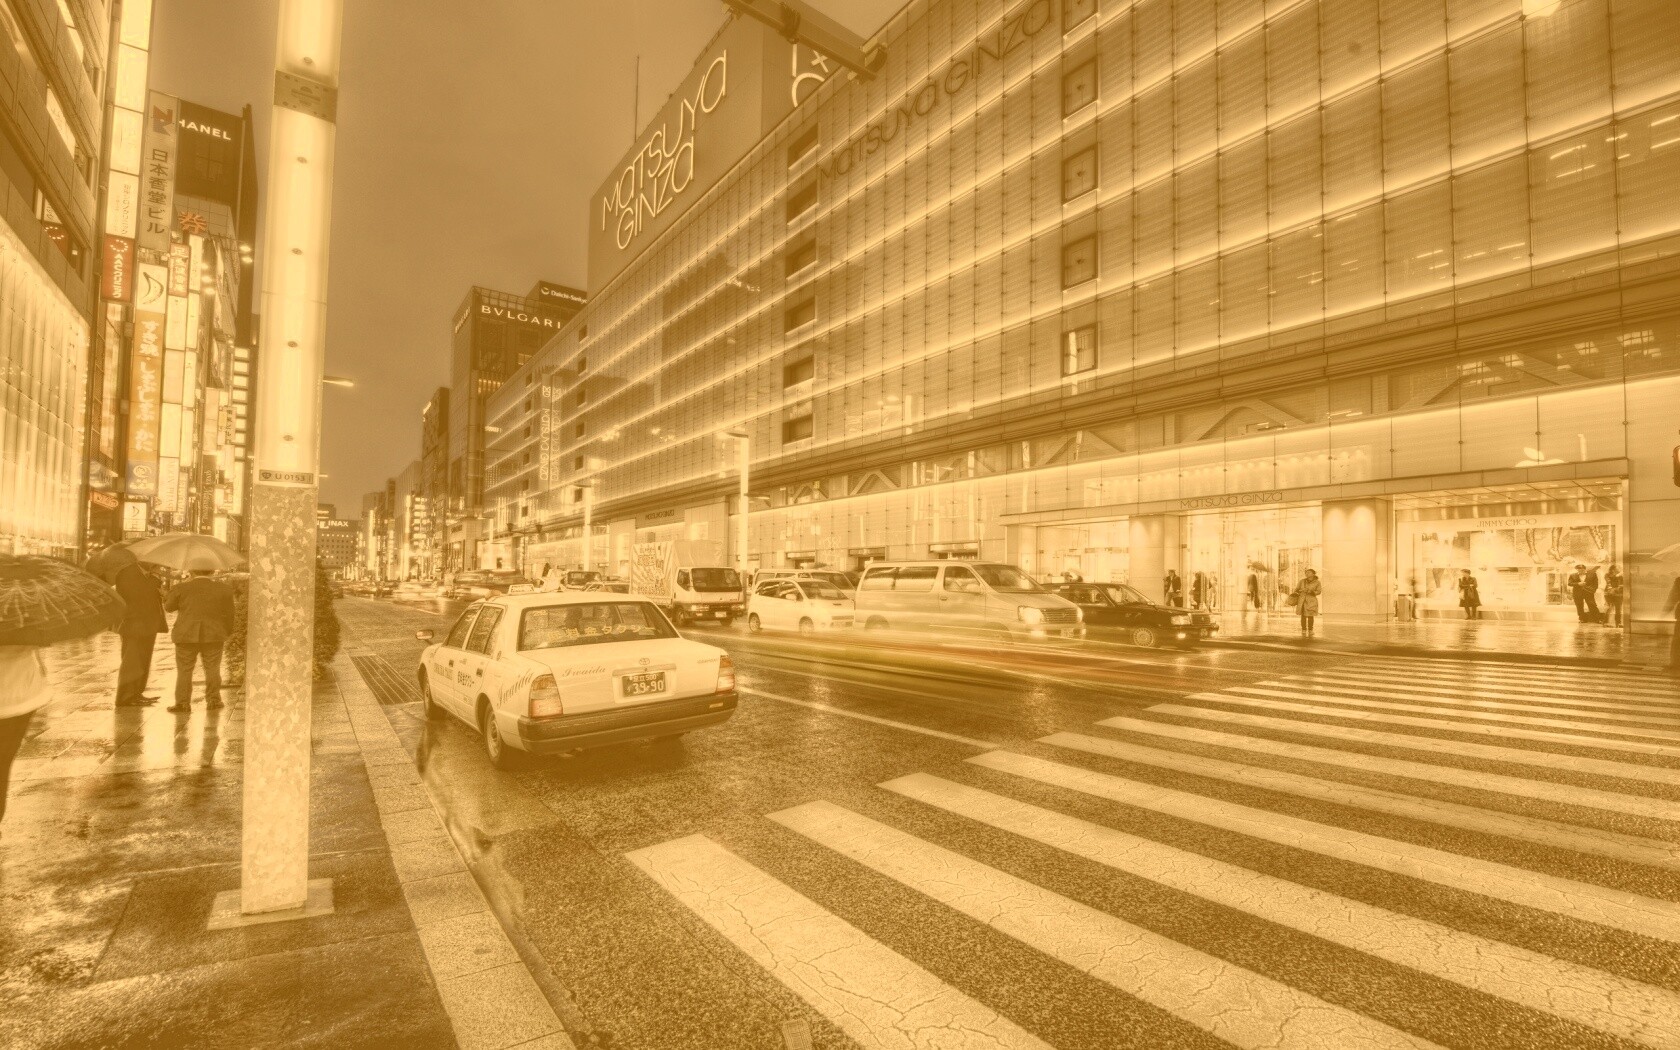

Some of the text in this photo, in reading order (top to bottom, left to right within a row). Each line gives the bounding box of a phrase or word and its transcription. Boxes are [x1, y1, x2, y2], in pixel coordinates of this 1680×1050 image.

[179, 119, 232, 141] HANEL
[147, 148, 169, 235] 日本香堂ビル
[481, 304, 561, 330] BVLGARI
[1477, 517, 1537, 530] JIMMY CHOO
